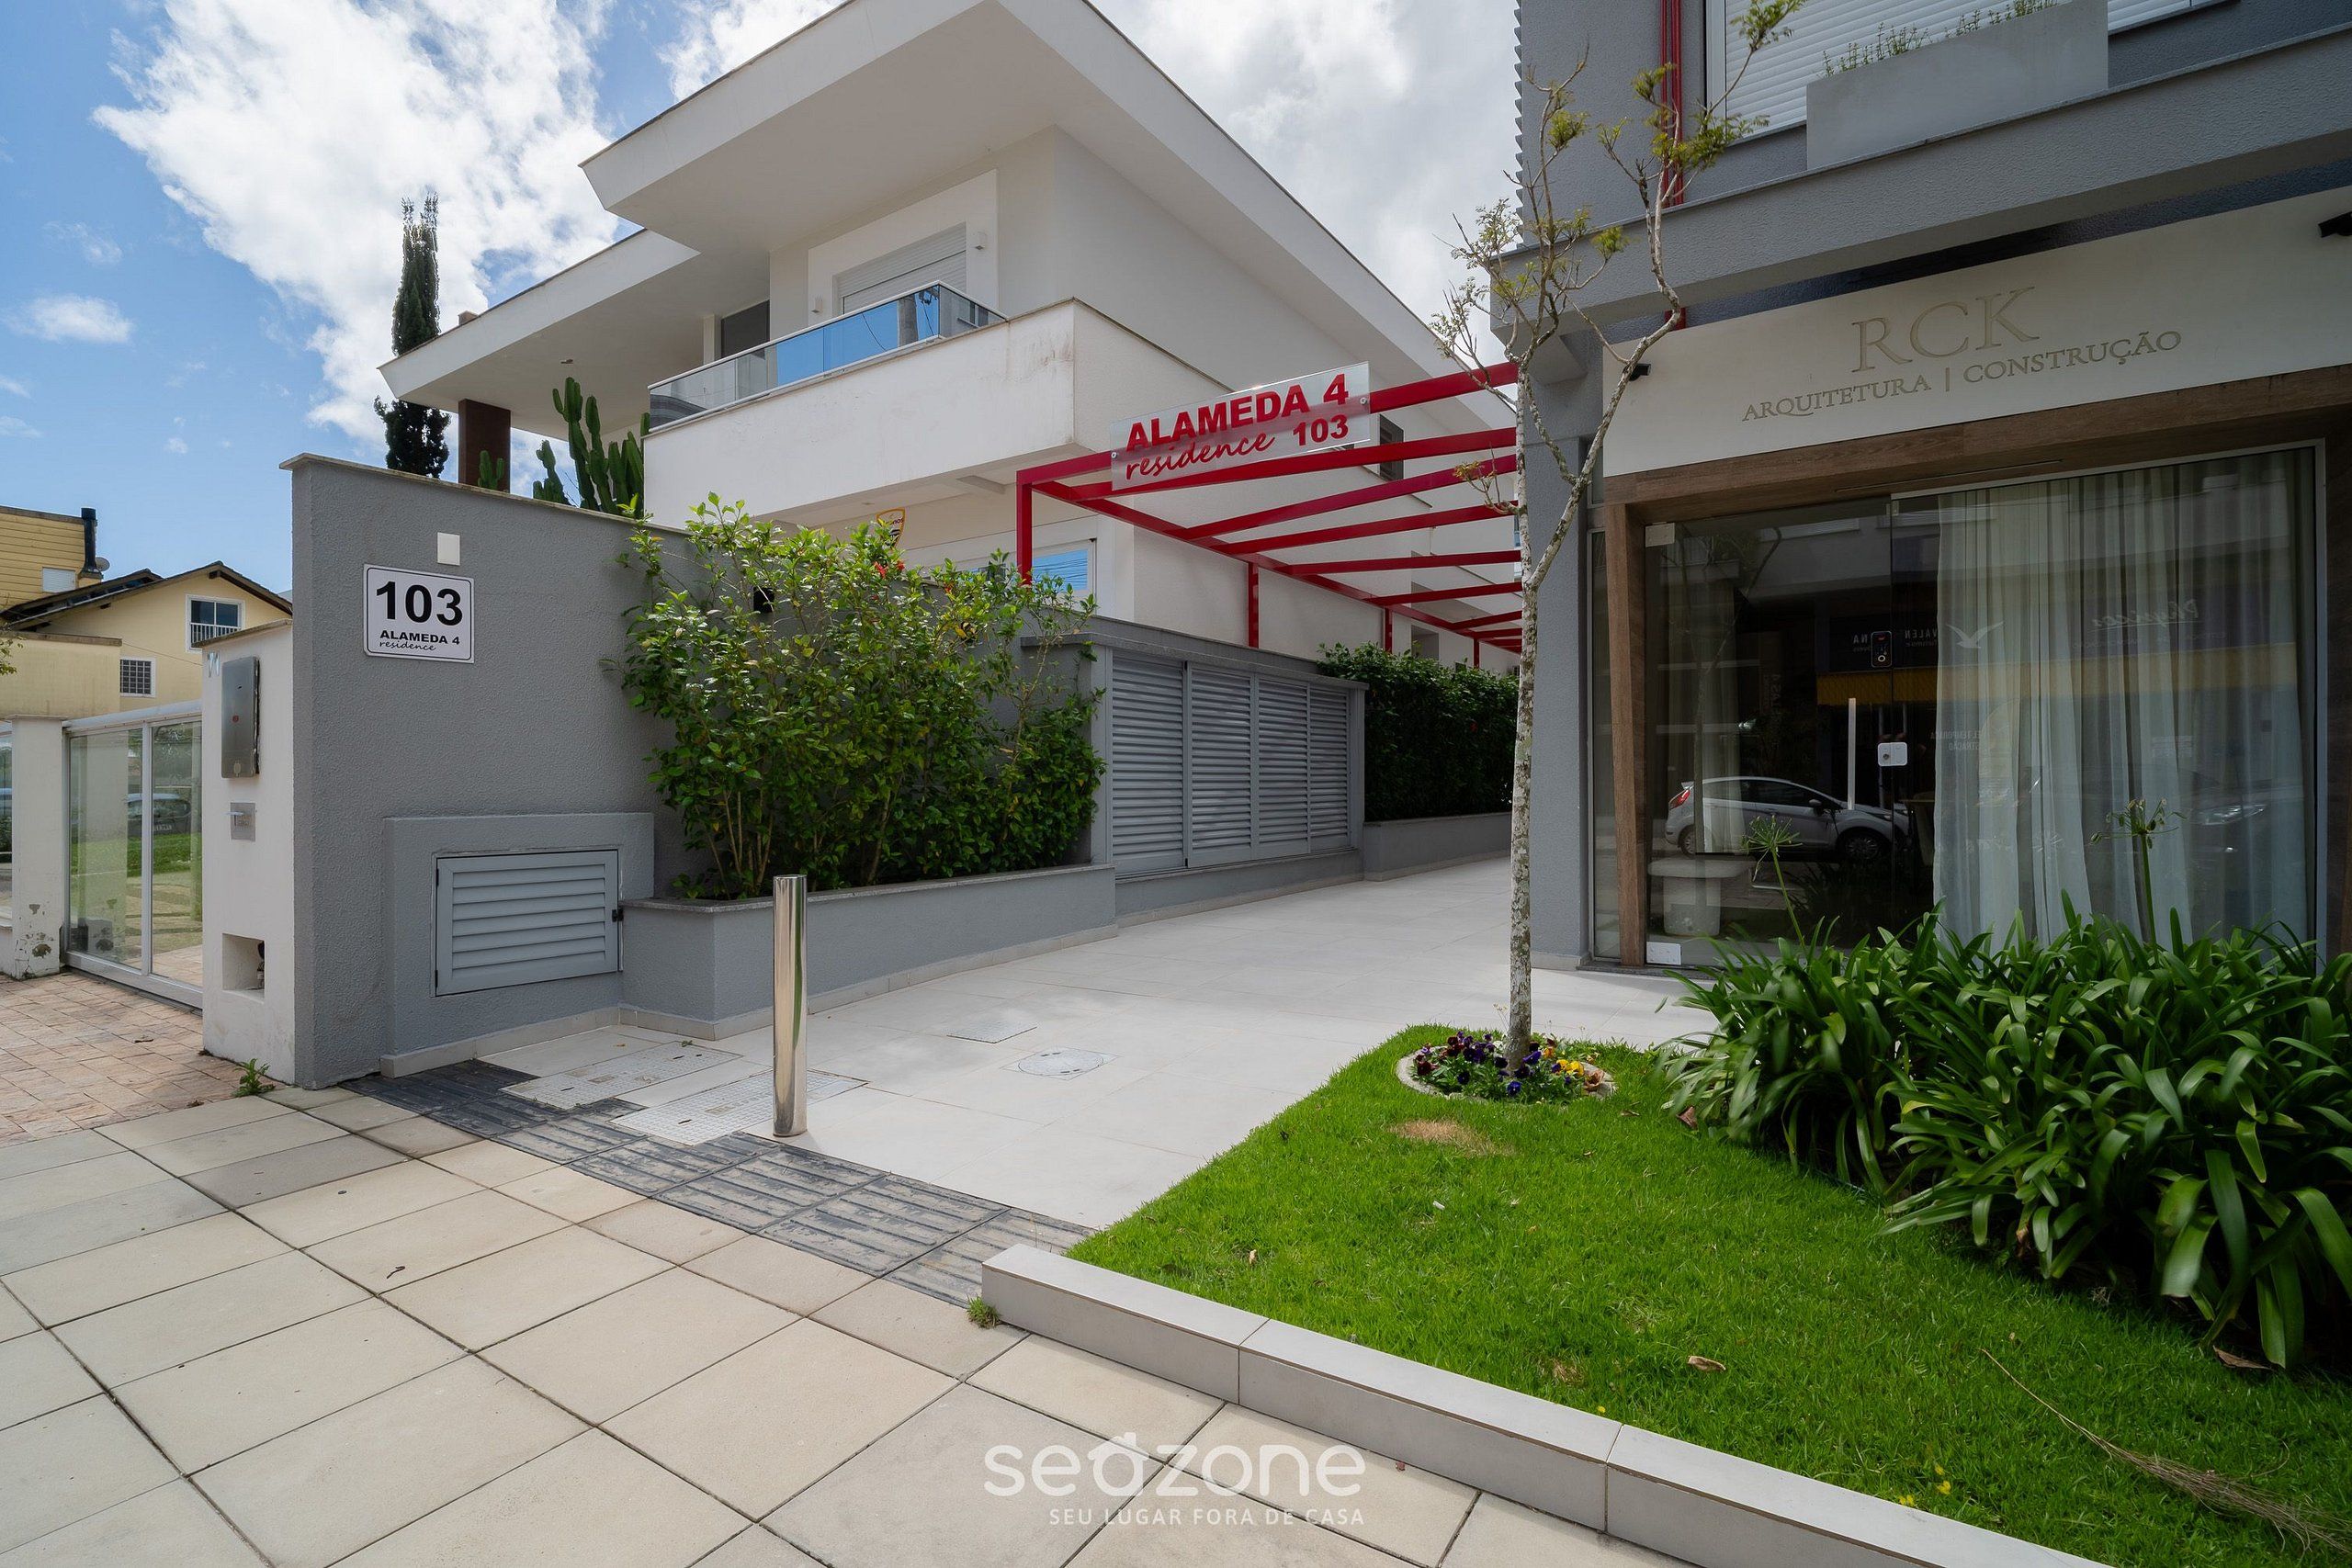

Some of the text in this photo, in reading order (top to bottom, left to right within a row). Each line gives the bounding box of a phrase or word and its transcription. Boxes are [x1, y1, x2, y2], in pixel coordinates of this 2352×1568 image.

[1851, 286, 2040, 373] RCK
[1741, 330, 2182, 422] ARQUITETURA CONSTRUÇÃO
[1125, 373, 1350, 452] ALAMEDA 4
[1125, 413, 1350, 481] residence 103
[376, 581, 463, 626] 103
[379, 629, 460, 645] ALAMEDA 4
[379, 640, 436, 651] residence
